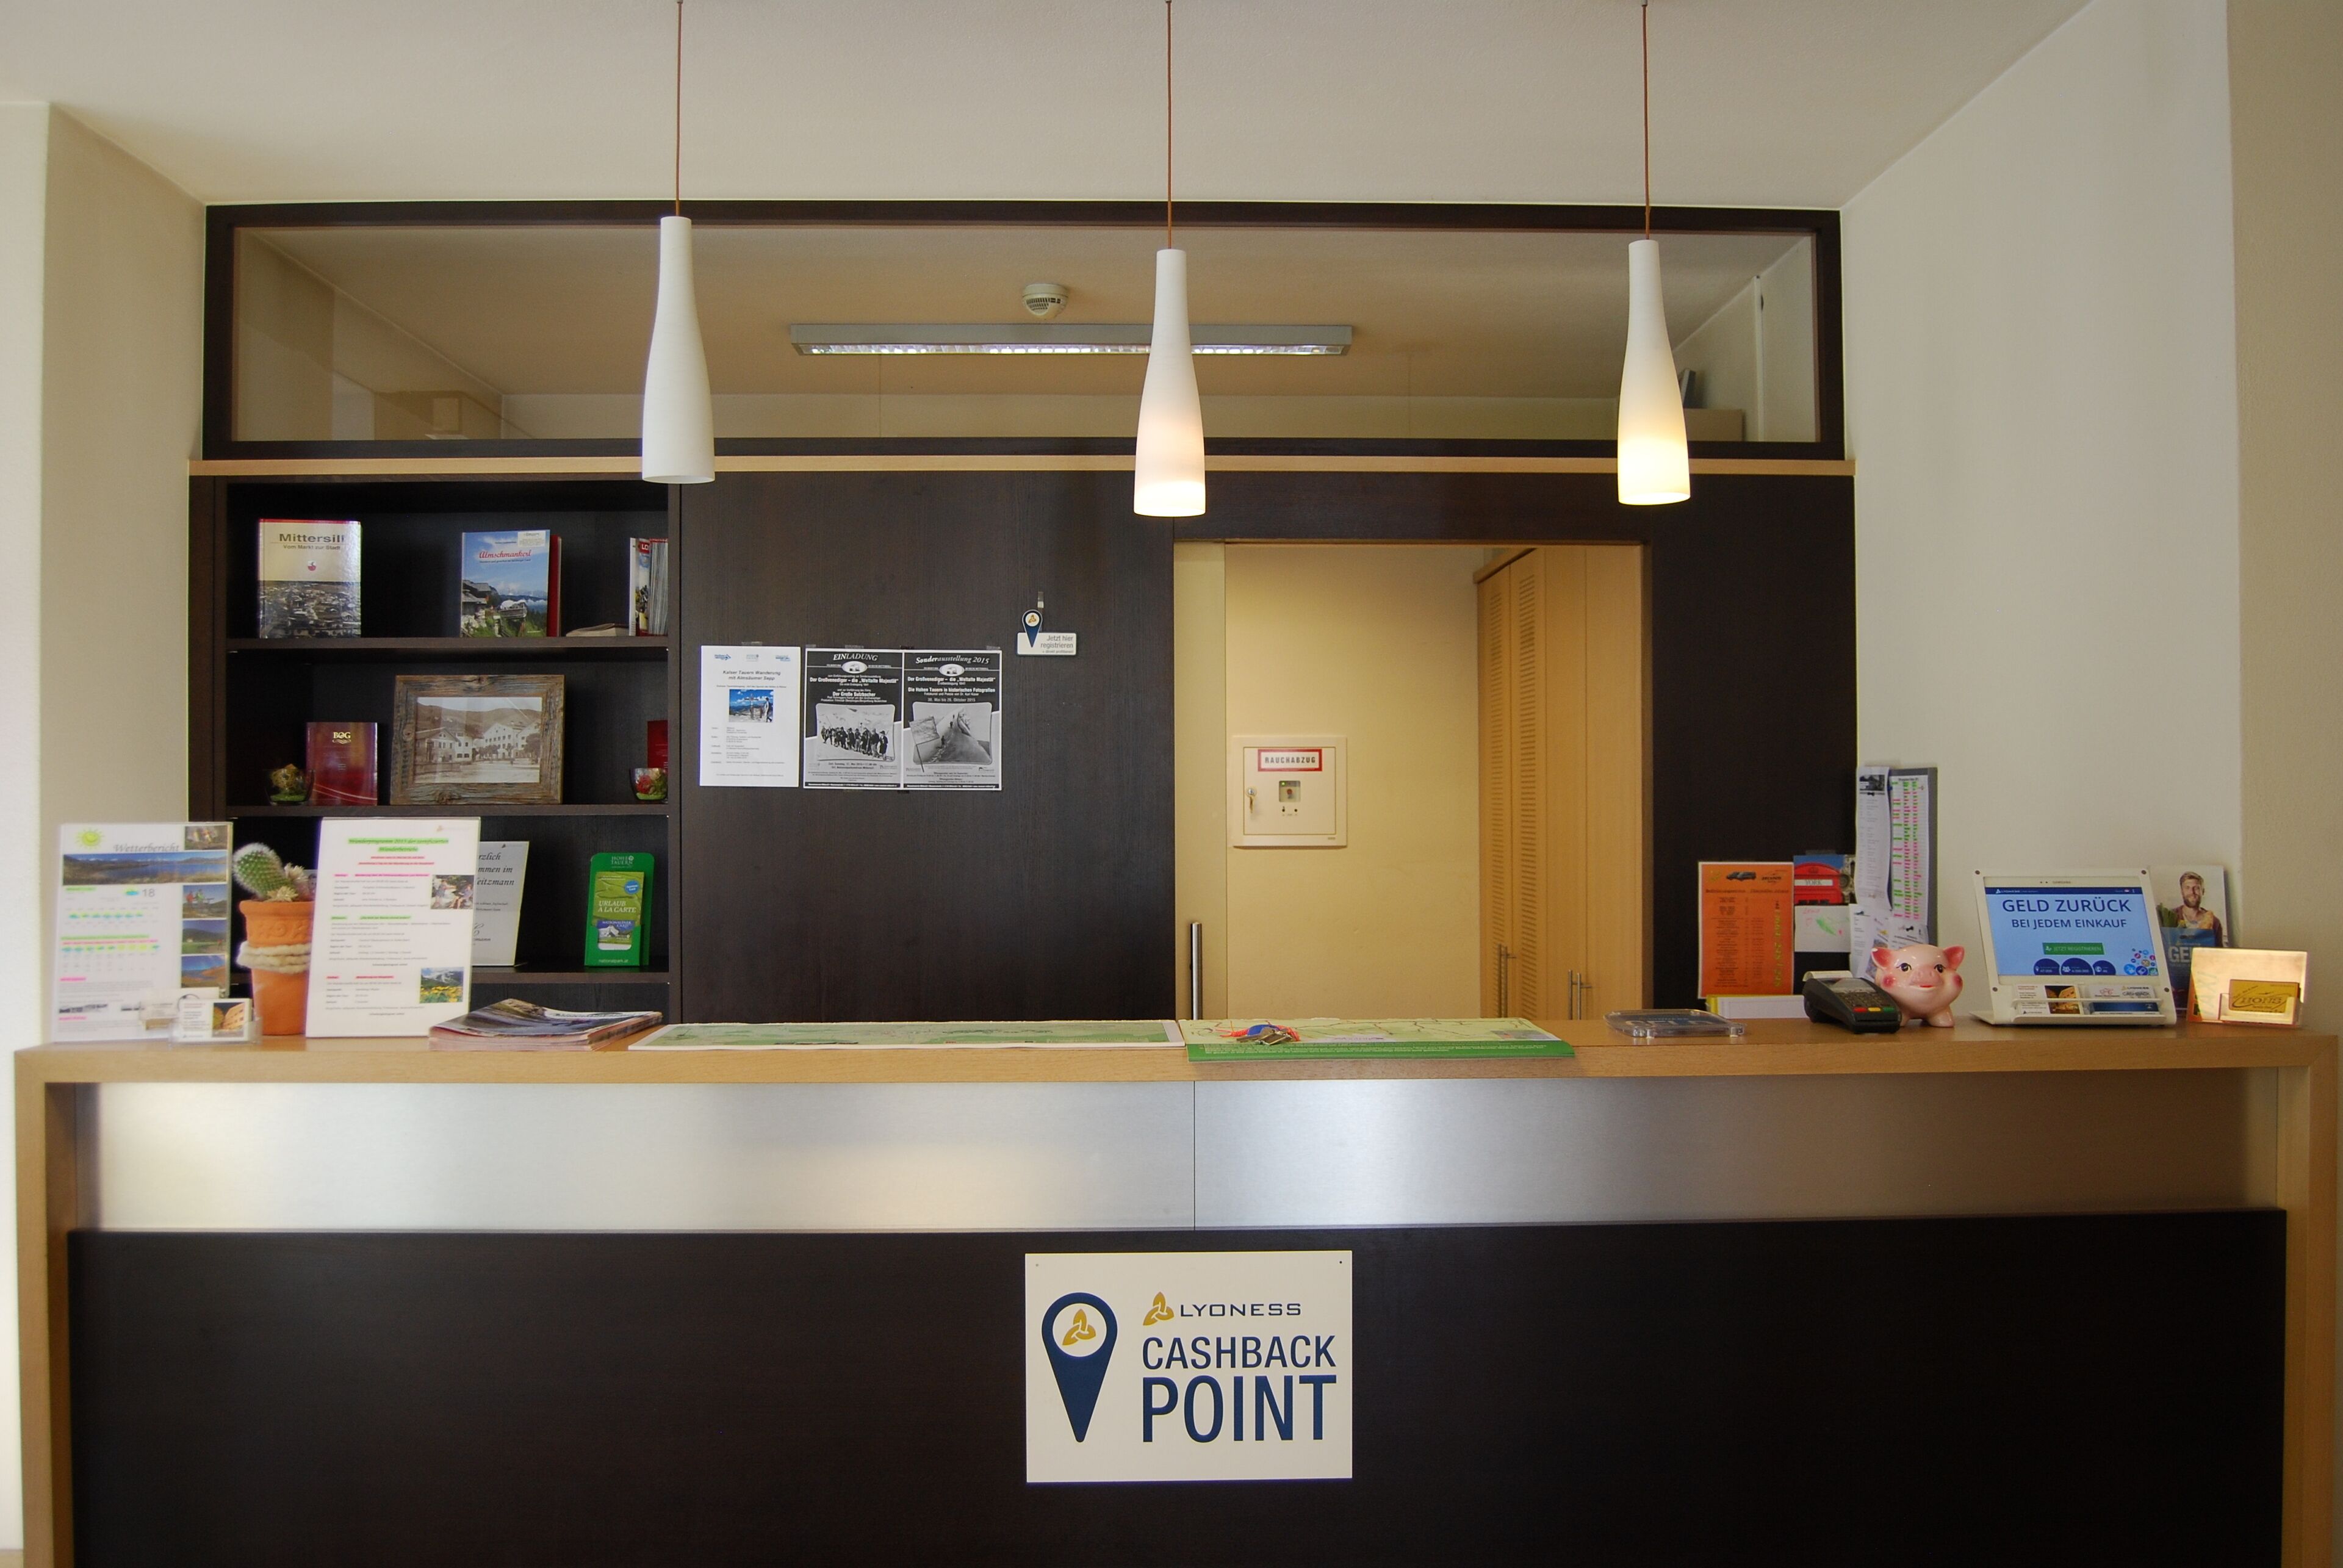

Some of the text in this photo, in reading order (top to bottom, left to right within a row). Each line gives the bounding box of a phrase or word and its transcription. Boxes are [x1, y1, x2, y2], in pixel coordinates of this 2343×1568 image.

[279, 533, 345, 542] Mittersill
[916, 655, 971, 664] Sonderausstellung
[113, 843, 179, 852] Wetterbericht
[143, 888, 155, 897] 18
[2002, 897, 2131, 912] GELD ZURÜCK
[2012, 919, 2127, 929] BEI JEDEM EINKAUF
[1181, 1303, 1301, 1317] LYONESS
[1142, 1335, 1336, 1370] CASHBACK
[1142, 1375, 1337, 1444] POINT
